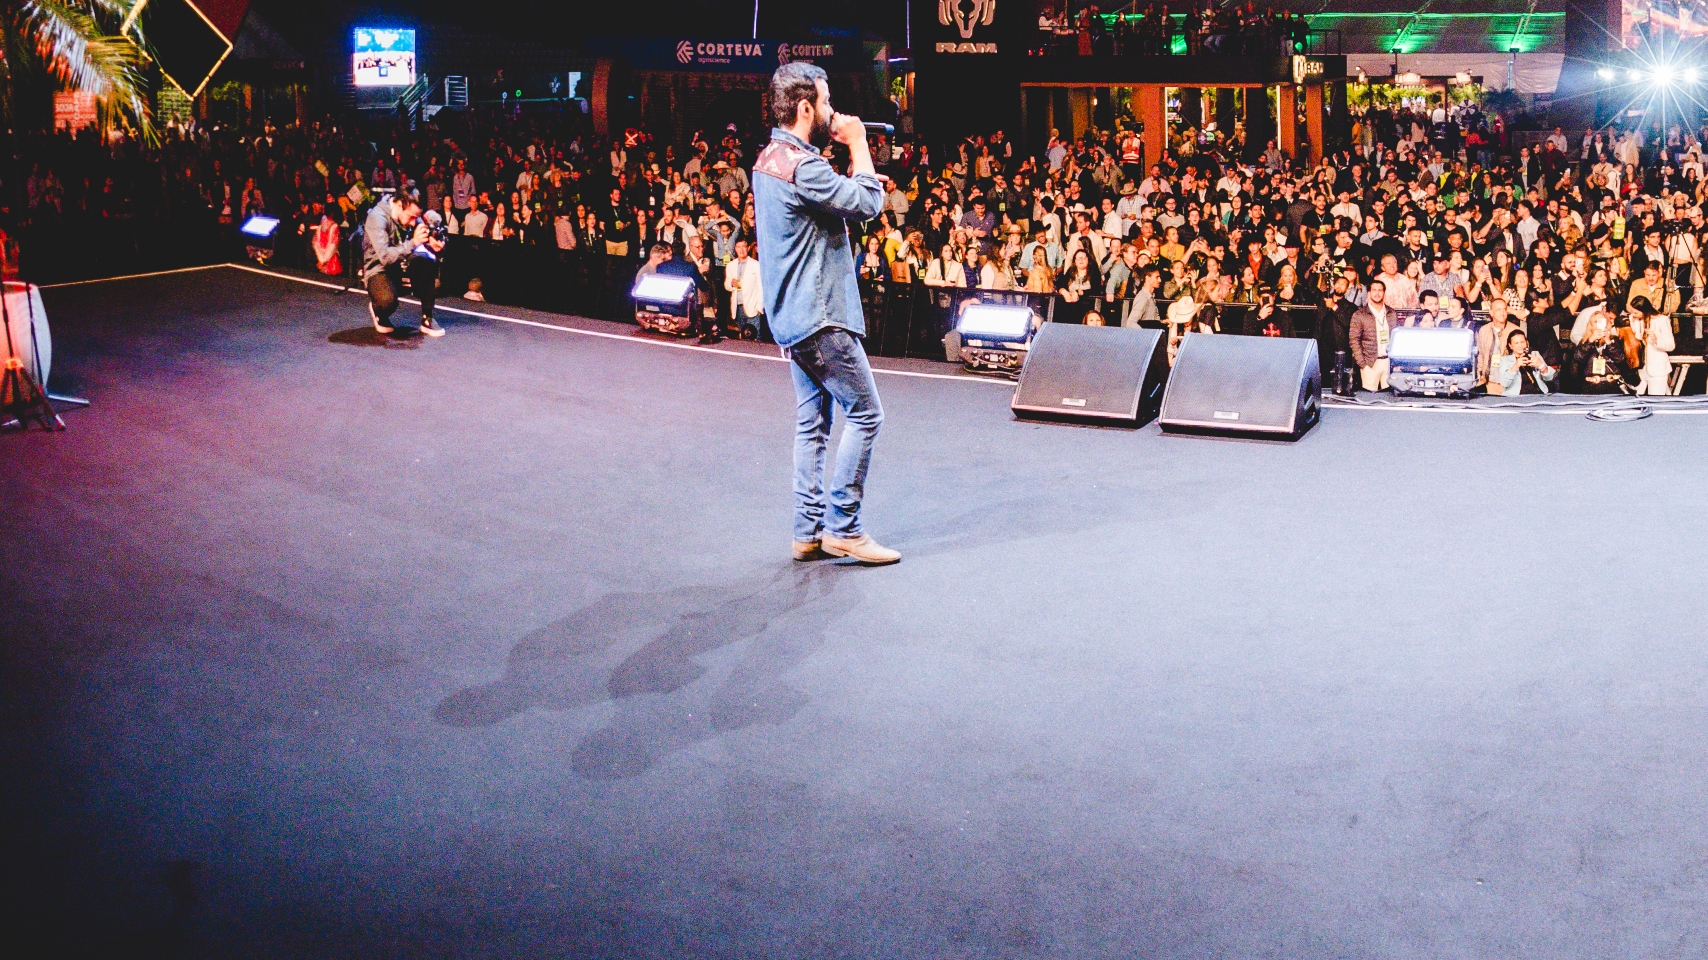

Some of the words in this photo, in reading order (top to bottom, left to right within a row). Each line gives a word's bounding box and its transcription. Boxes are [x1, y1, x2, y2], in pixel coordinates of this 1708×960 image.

[697, 43, 763, 56] CORTEVA
[792, 44, 834, 56] CORTEVA
[935, 42, 998, 53] RAM
